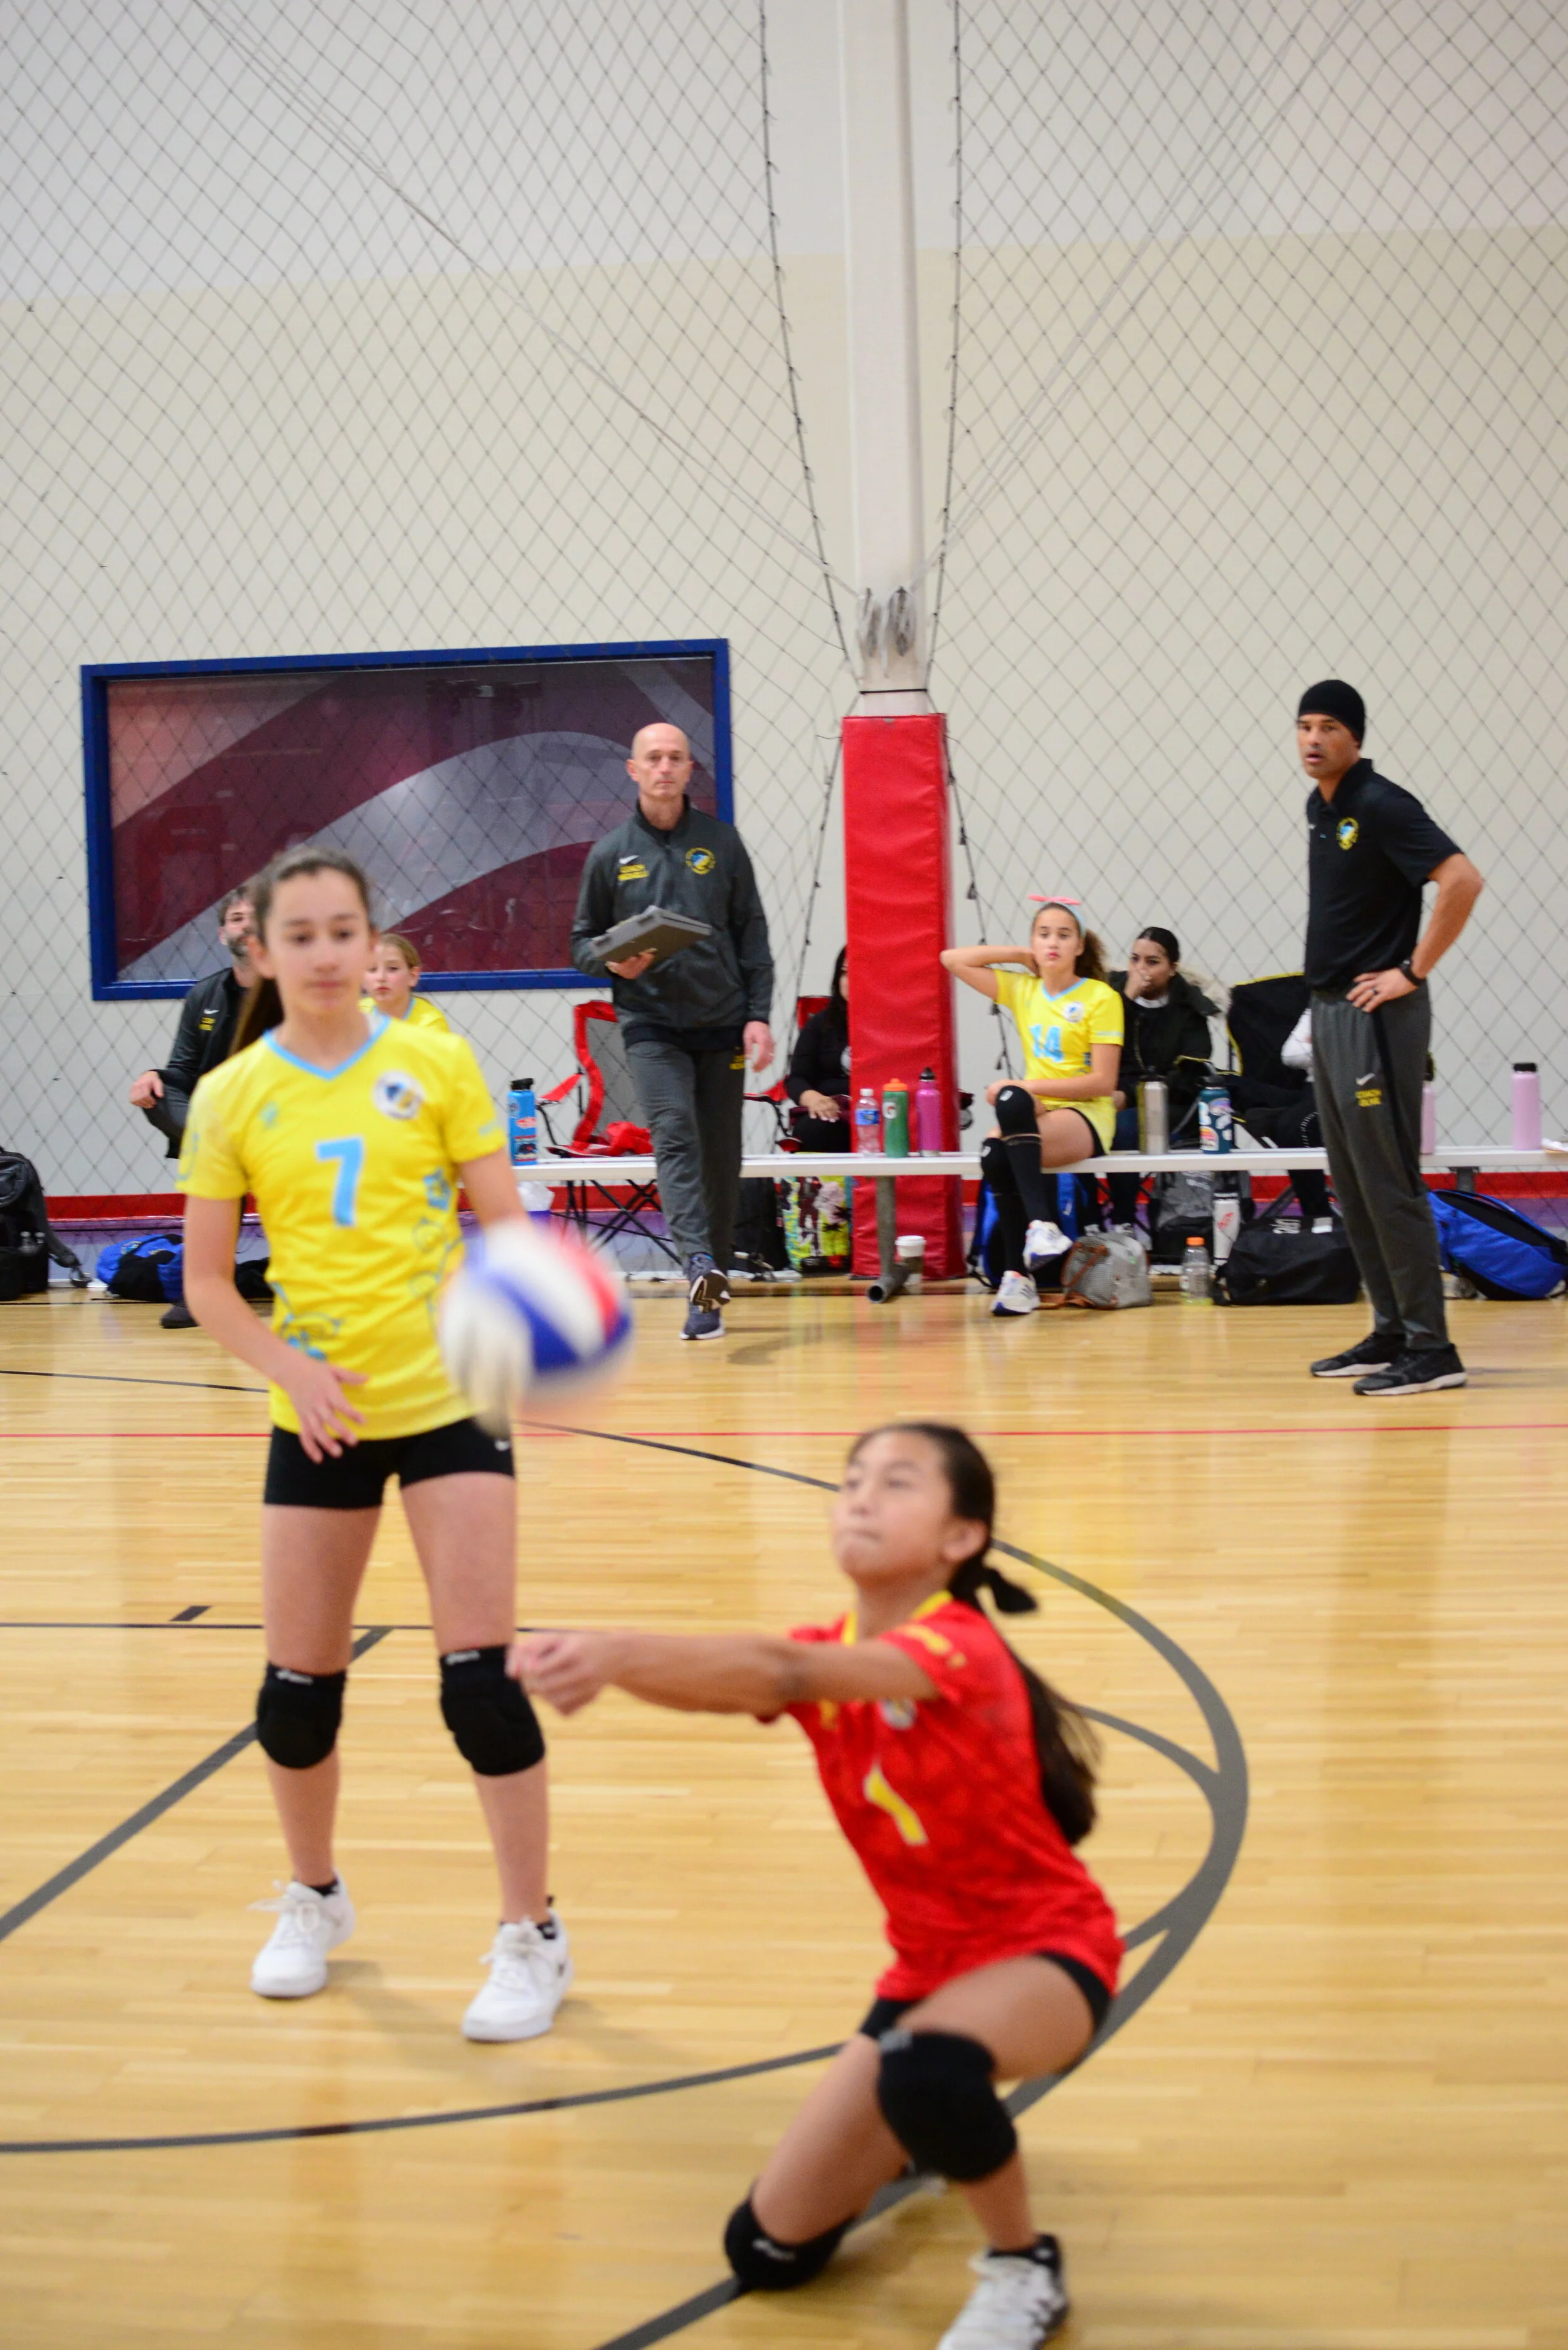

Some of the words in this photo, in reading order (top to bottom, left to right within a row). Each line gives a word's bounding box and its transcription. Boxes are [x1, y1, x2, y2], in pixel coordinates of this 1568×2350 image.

[1029, 1023, 1064, 1062] 14
[882, 1102, 898, 1119] G
[314, 1137, 364, 1228] 7
[864, 1762, 928, 1845] 1
